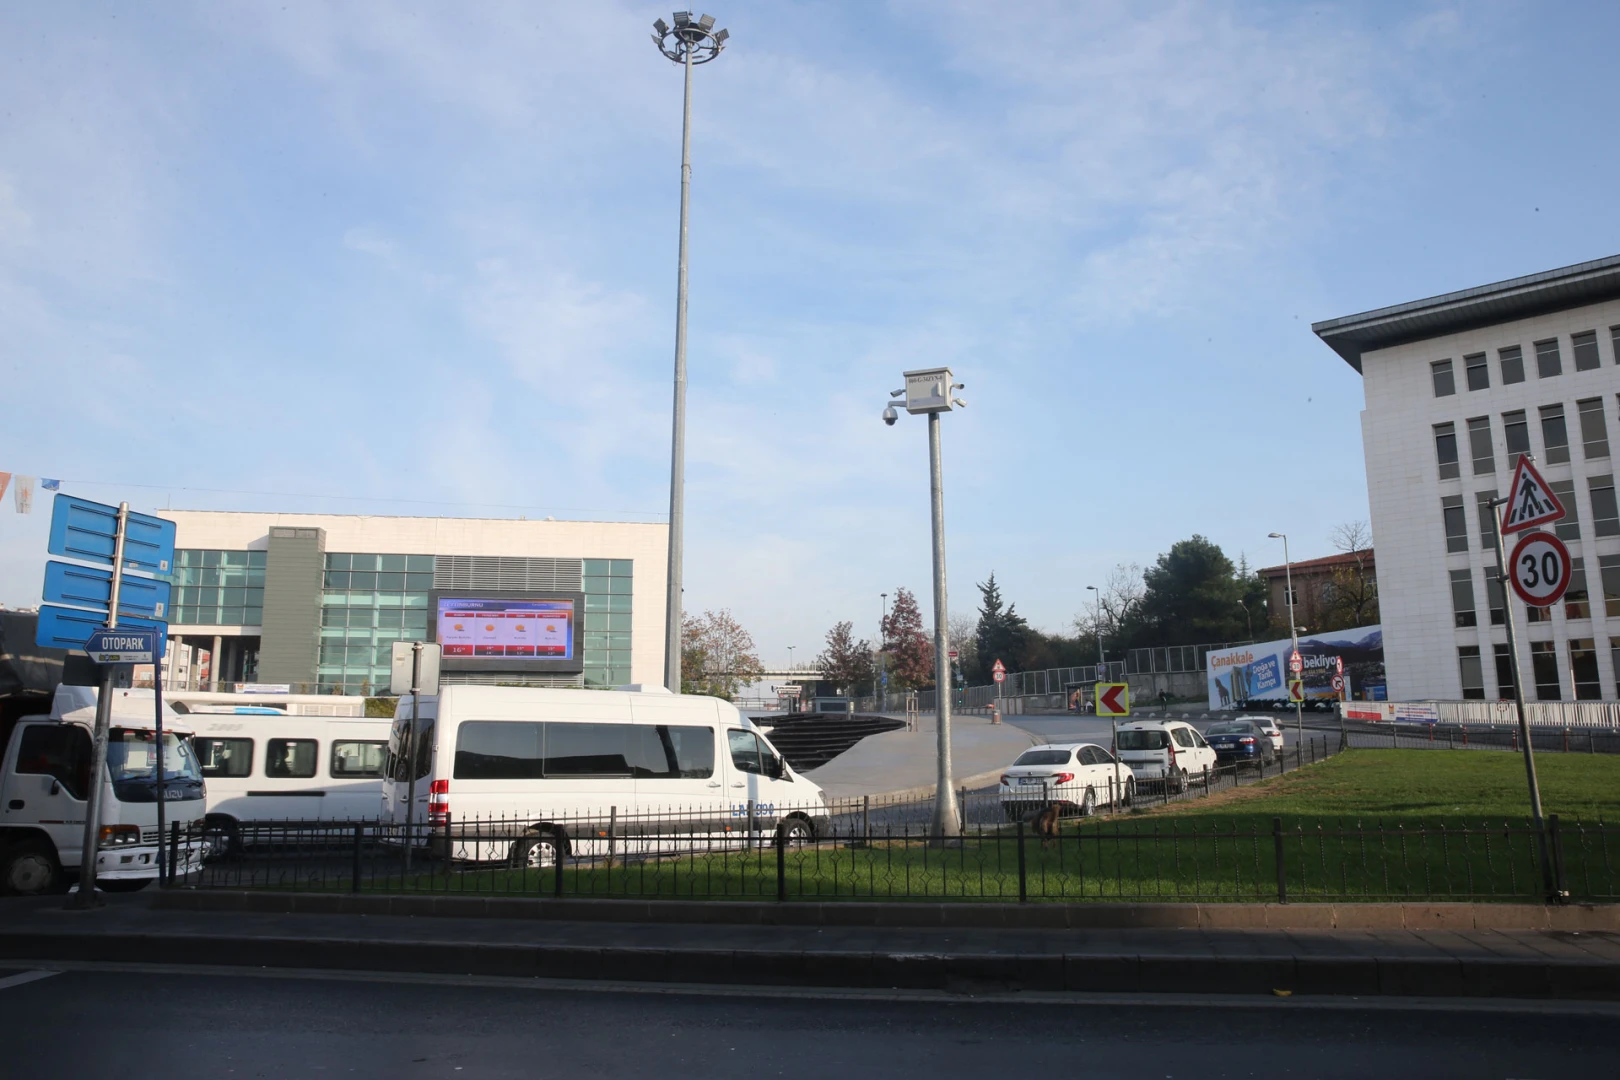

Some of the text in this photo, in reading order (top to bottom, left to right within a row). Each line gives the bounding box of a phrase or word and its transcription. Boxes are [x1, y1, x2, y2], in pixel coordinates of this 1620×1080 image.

[1521, 551, 1559, 588] 30
[102, 637, 144, 650] OTOPARK
[1211, 651, 1254, 671] Çanakkale
[1252, 660, 1276, 673] Doğa ve
[1258, 669, 1273, 681] Tarih
